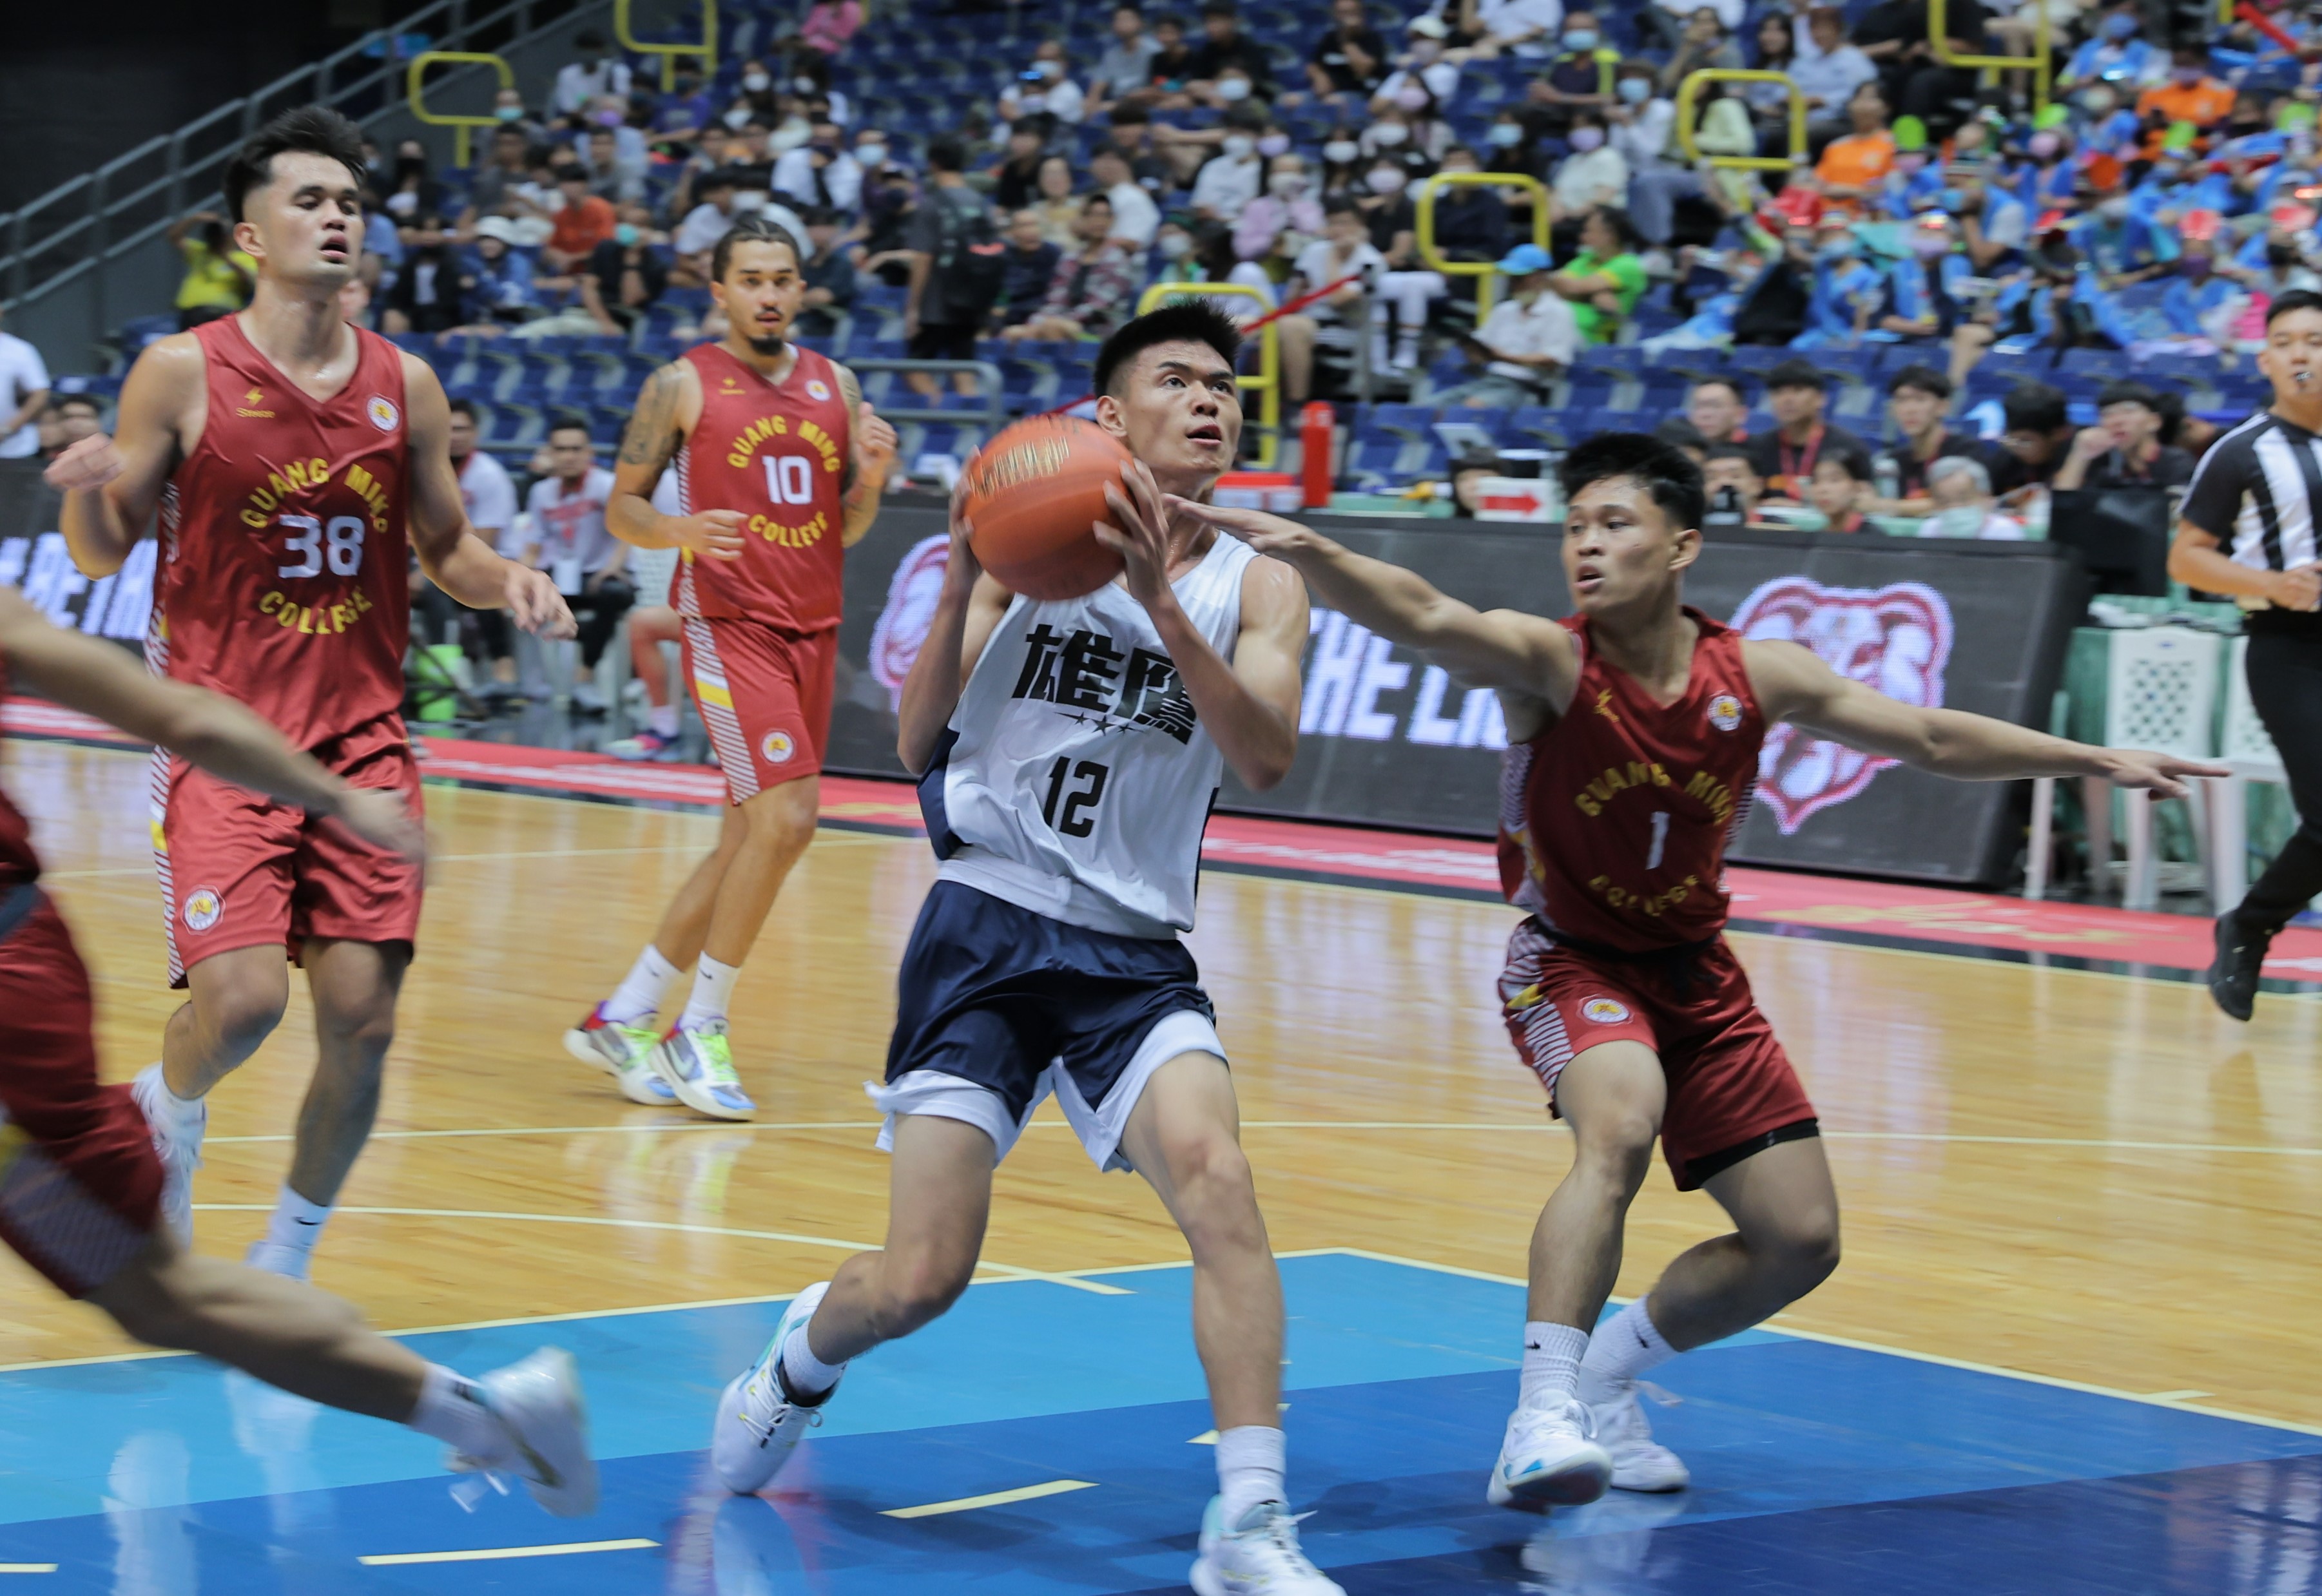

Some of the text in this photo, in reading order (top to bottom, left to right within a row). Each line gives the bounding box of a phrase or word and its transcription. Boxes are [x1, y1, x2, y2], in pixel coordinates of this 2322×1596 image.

[239, 457, 331, 529] GUANG
[762, 455, 813, 505] 10
[278, 514, 365, 579] 38
[1043, 756, 1109, 838] 12
[1645, 811, 1670, 870] 1
